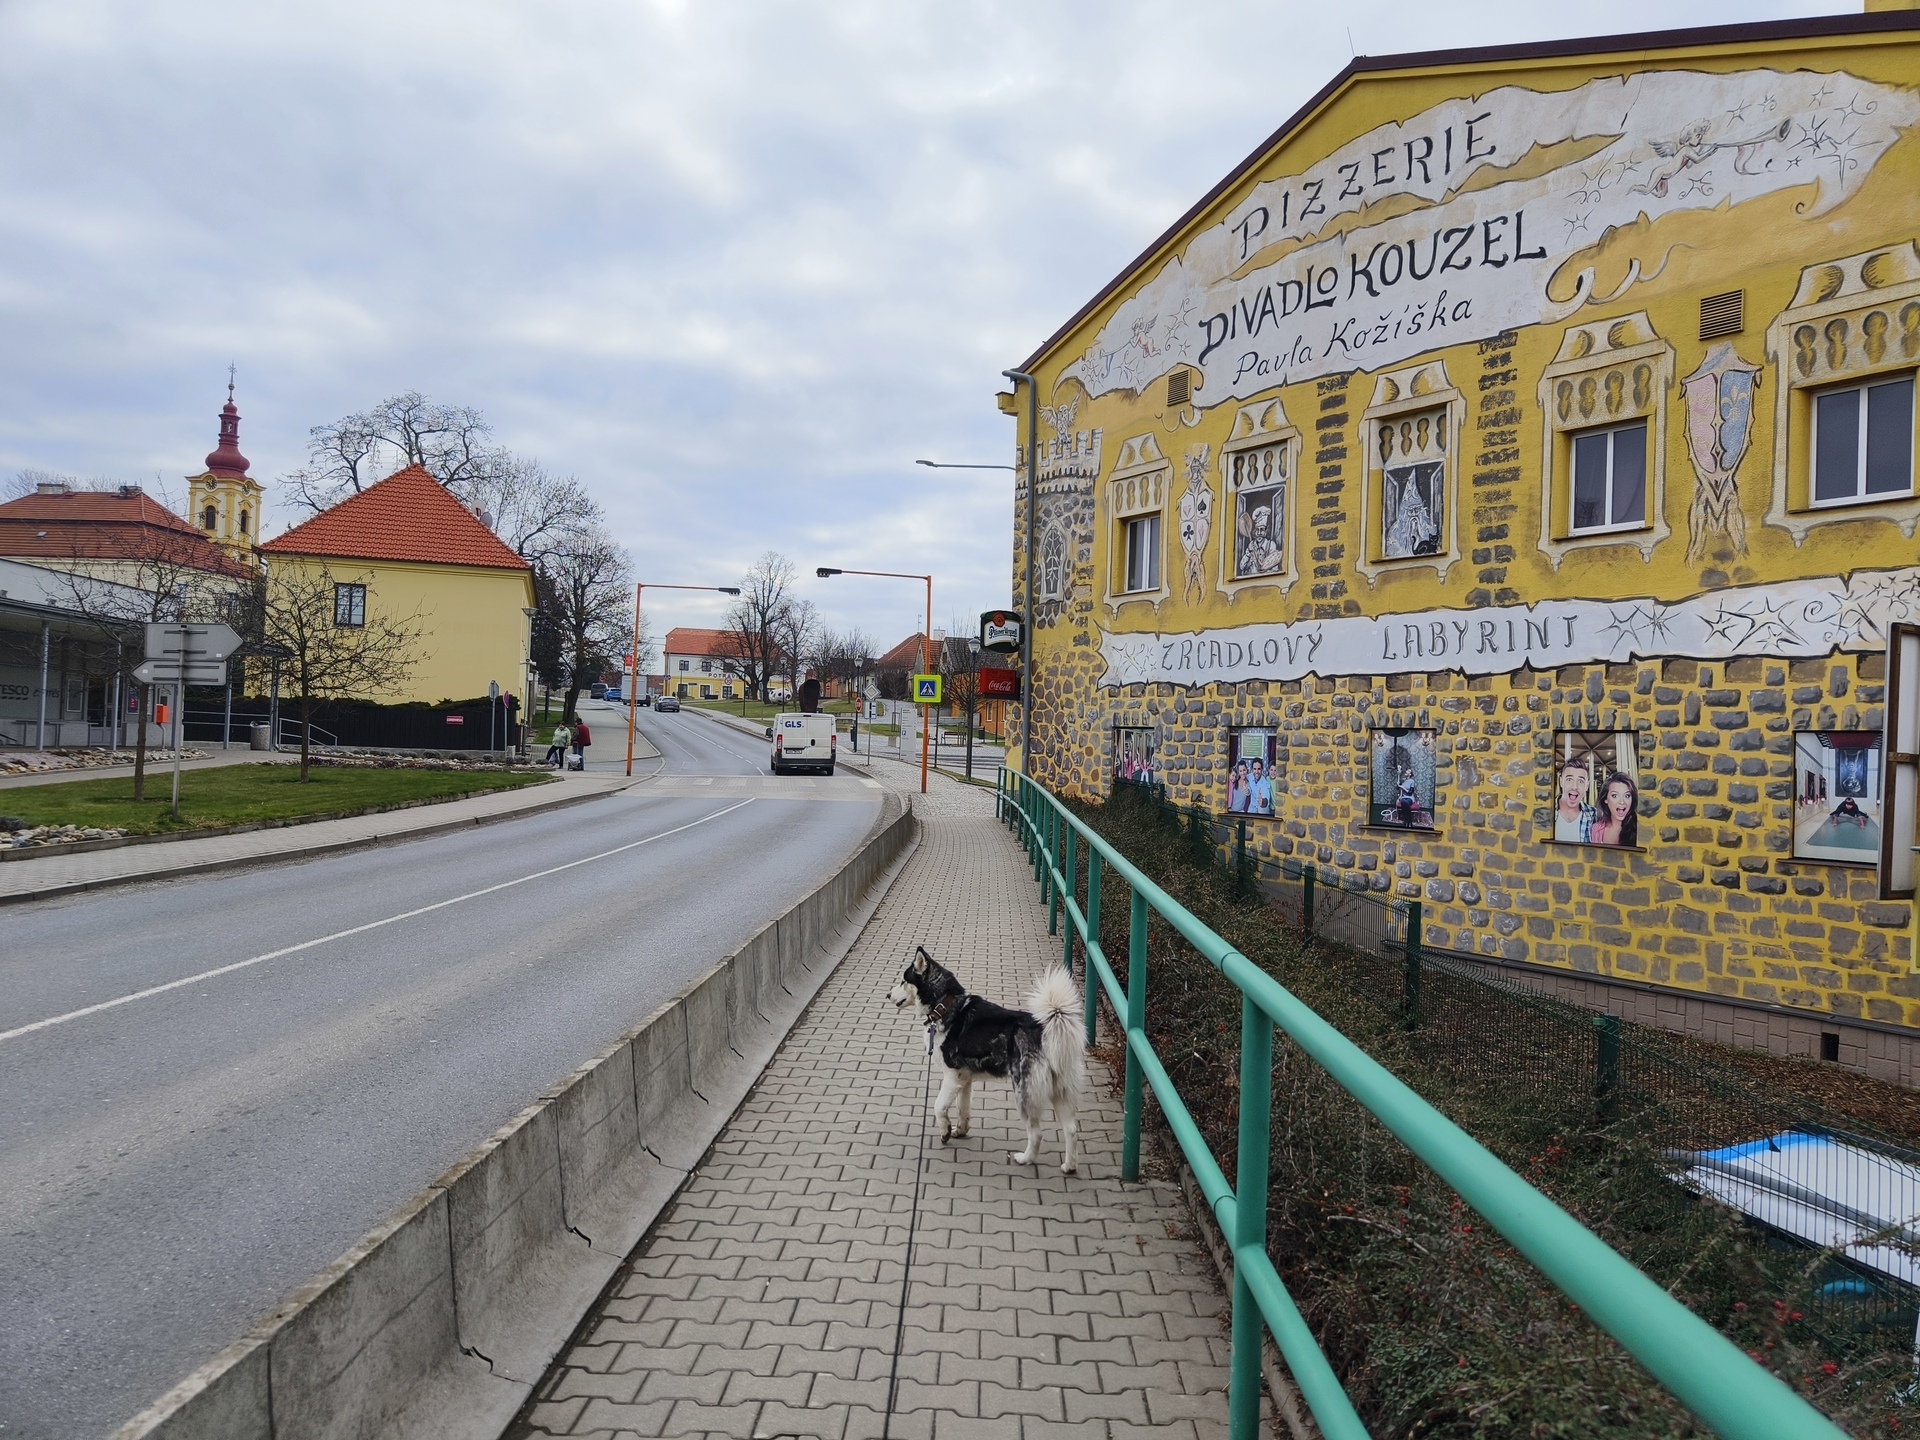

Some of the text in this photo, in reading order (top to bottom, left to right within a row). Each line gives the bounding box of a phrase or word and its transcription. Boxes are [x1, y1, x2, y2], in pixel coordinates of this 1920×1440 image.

[1231, 112, 1496, 259] PIZZERIE
[1199, 209, 1547, 352] DIVADLO KOUZEL
[1232, 289, 1472, 386] Pavla Kožíška
[1161, 614, 1579, 671] ZRCADLOVÝ LABYRINT
